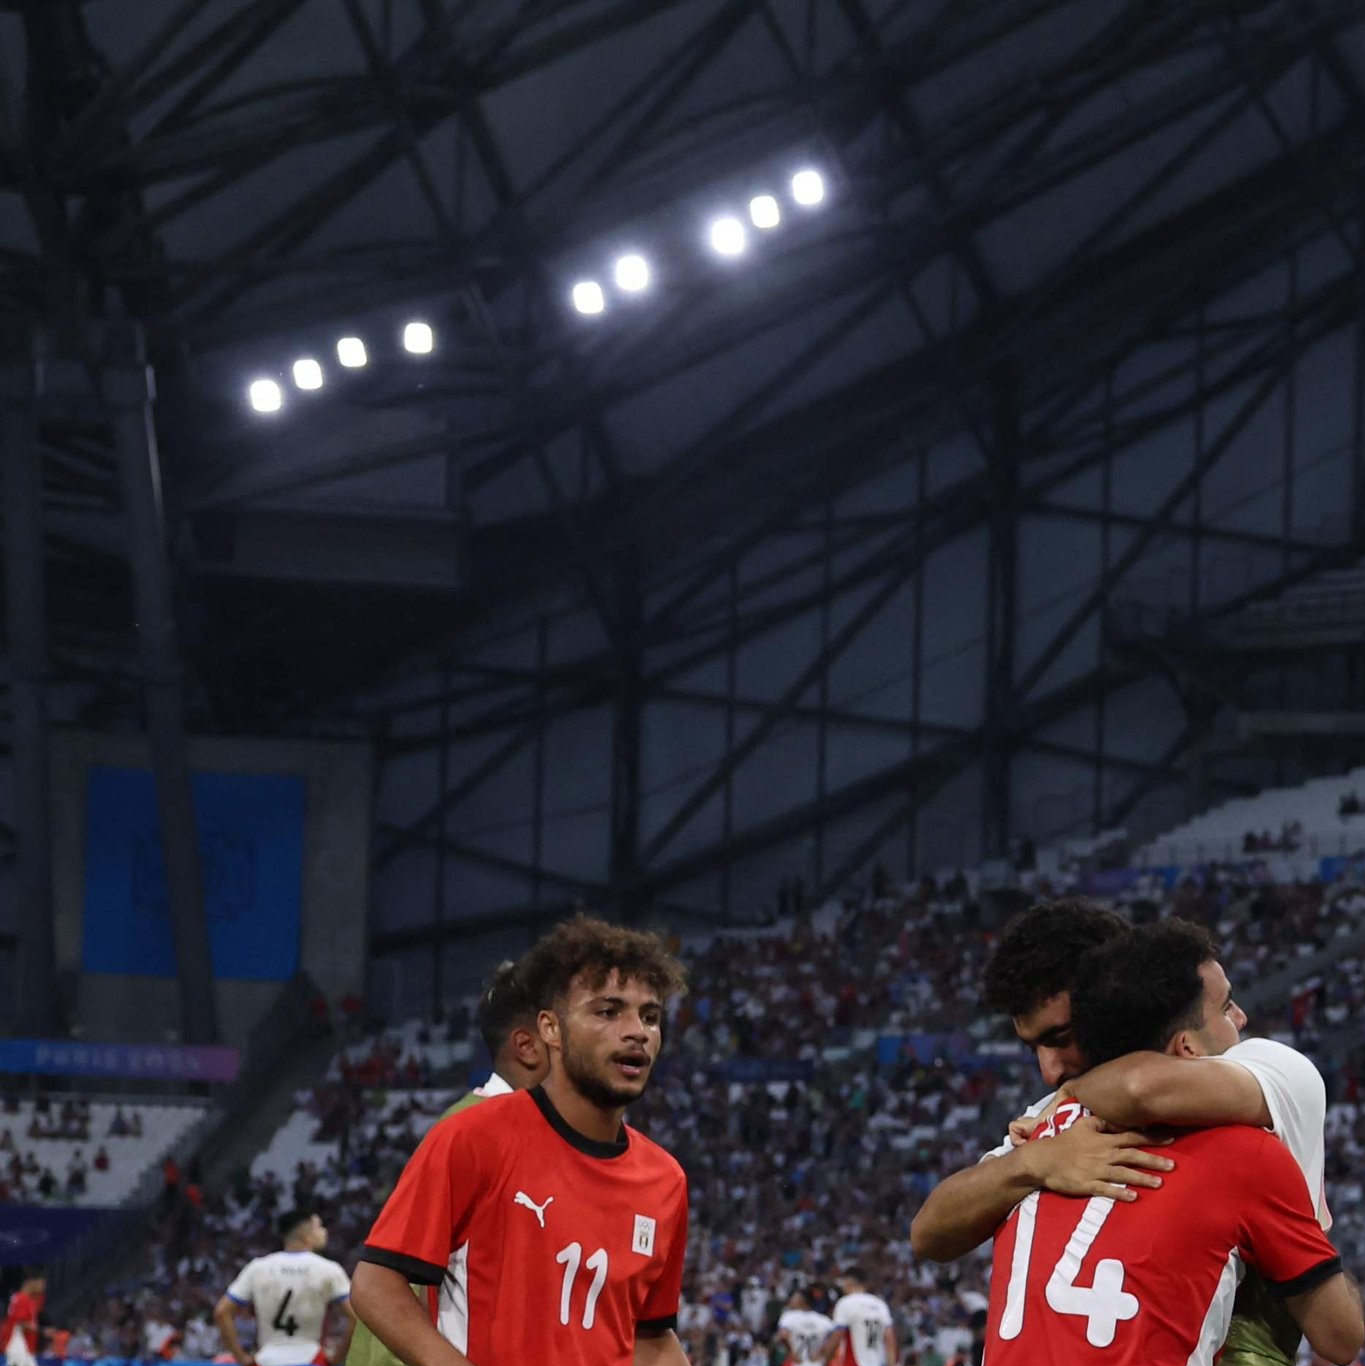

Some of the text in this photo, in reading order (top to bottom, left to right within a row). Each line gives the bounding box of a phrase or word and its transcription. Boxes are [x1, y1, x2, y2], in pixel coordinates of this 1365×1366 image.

[555, 1241, 609, 1330] 11
[998, 1181, 1140, 1348] 14
[273, 1288, 299, 1338] 4
